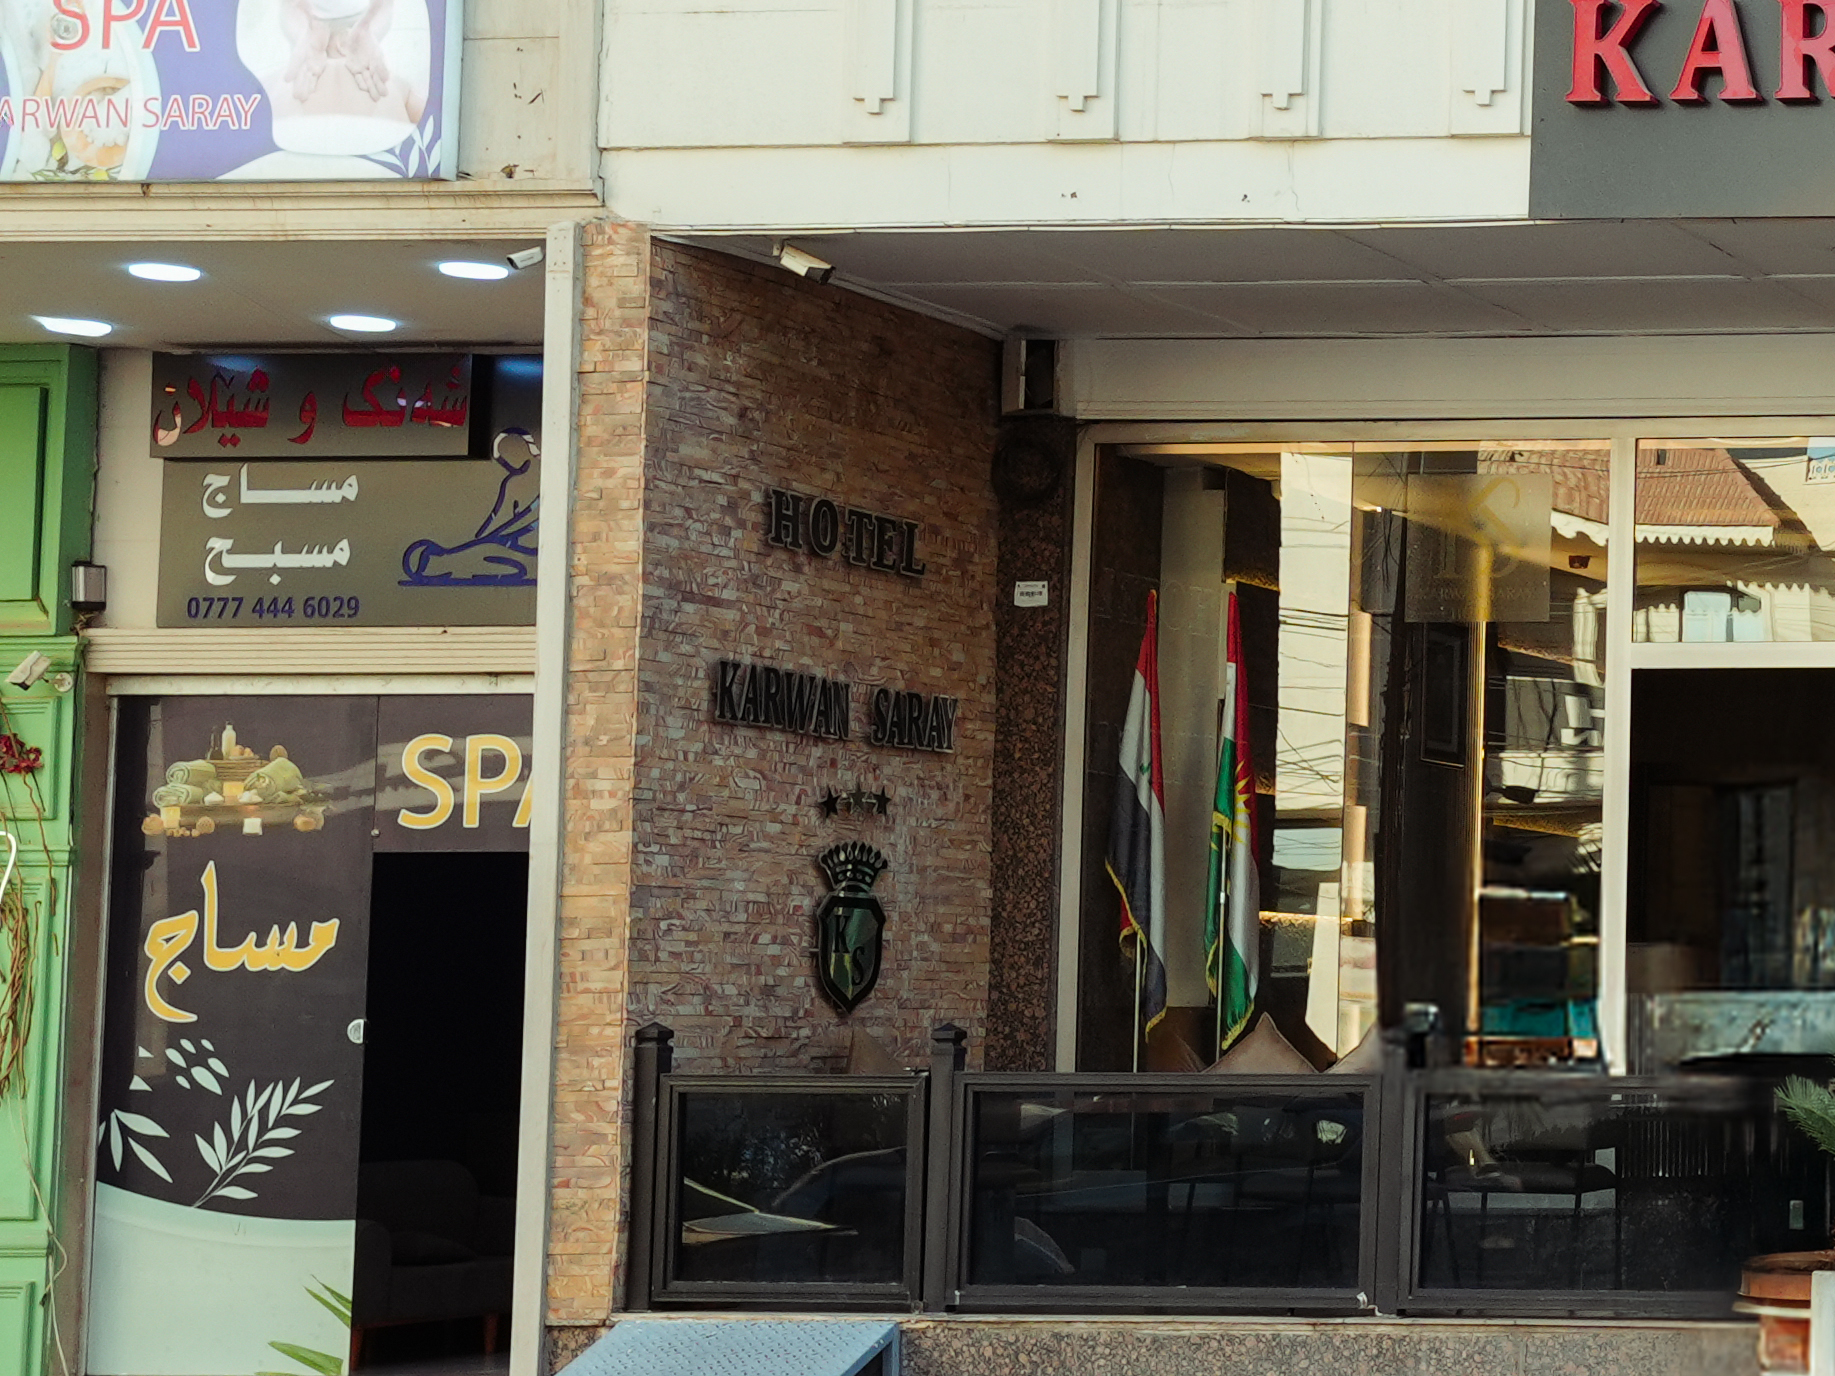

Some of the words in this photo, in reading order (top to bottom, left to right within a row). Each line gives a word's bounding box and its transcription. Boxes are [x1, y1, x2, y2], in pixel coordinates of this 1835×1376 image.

[141, 93, 261, 130] SARAY
[287, 390, 319, 445] و
[201, 462, 360, 519] مساج
[768, 487, 927, 577] HOTEL
[203, 535, 352, 587] مسبح
[186, 595, 244, 620] 0777
[251, 595, 296, 620] 444
[302, 595, 361, 620] 6029
[713, 658, 853, 742] KARWAN
[869, 686, 959, 754] SARAY
[145, 860, 341, 1022] مساج
